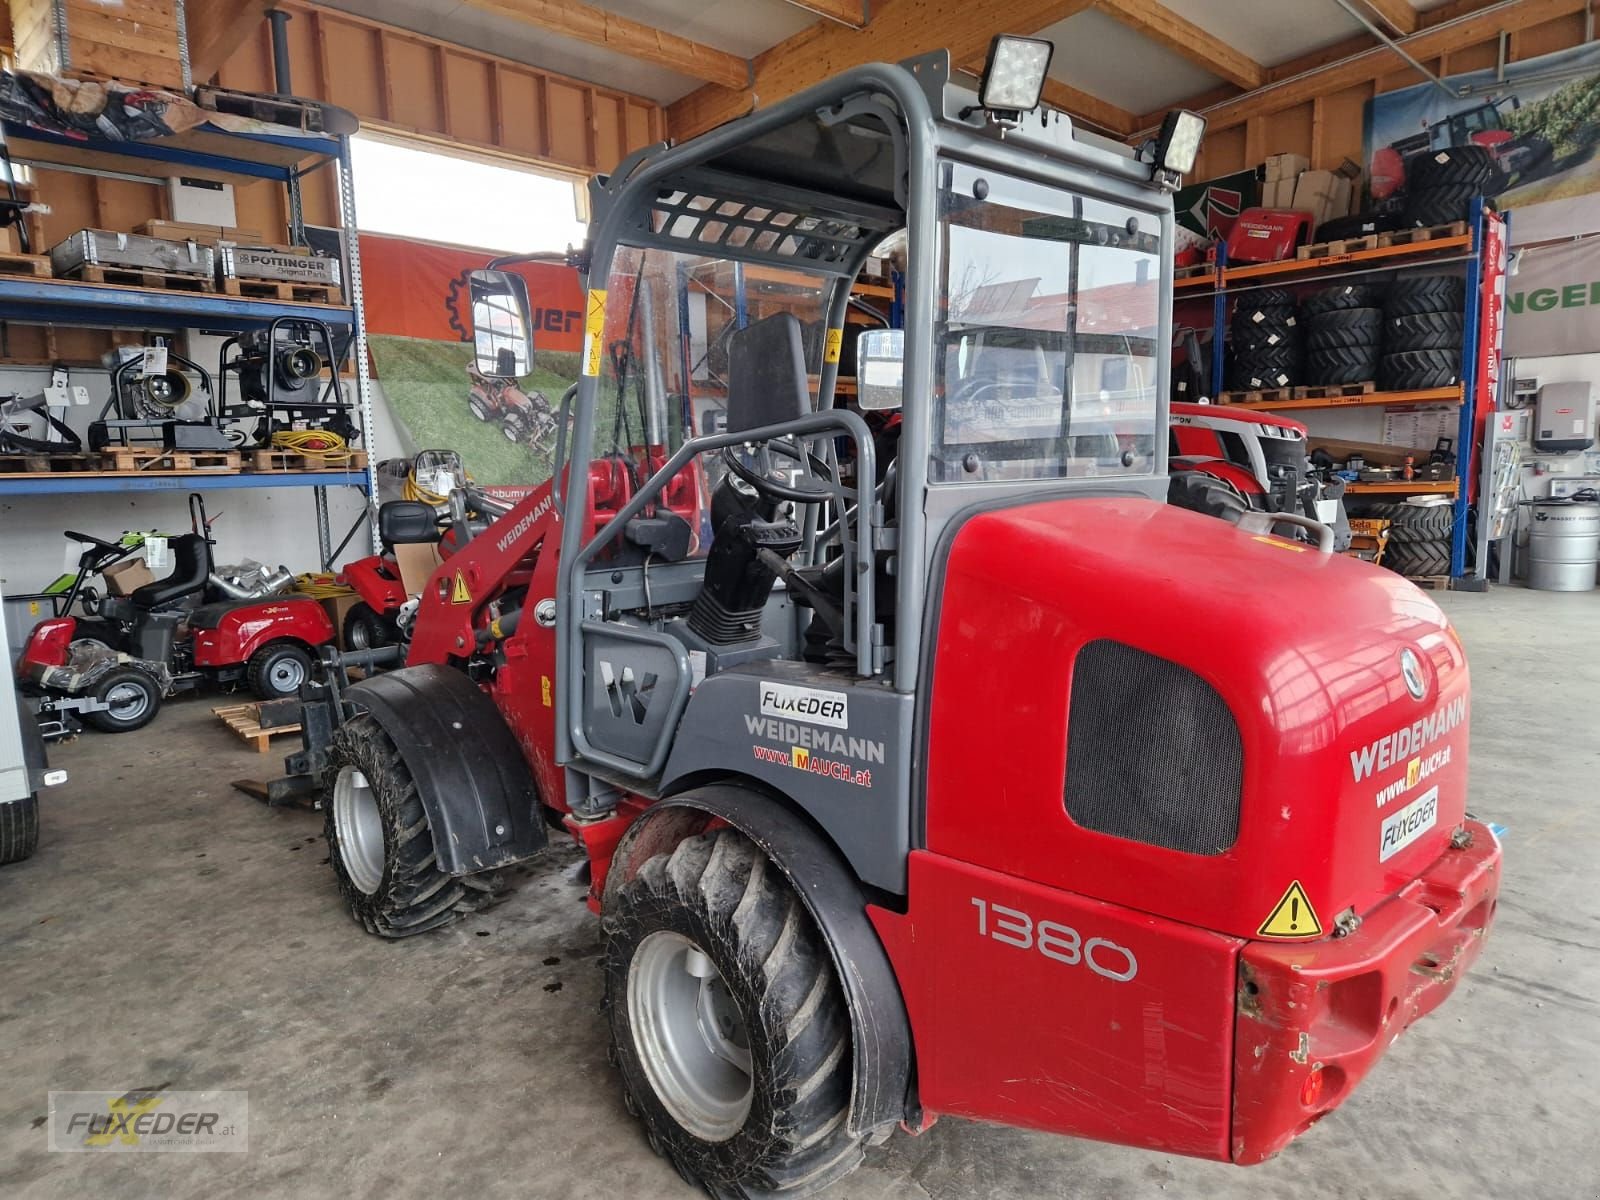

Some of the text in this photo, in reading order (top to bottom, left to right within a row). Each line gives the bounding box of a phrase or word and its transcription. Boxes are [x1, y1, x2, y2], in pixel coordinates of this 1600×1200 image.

[1240, 222, 1284, 232] WEIDEMANN
[744, 714, 885, 764] WEIDEMANN
[1350, 694, 1466, 783] WEIDEMANN
[971, 897, 1138, 982] 1380
